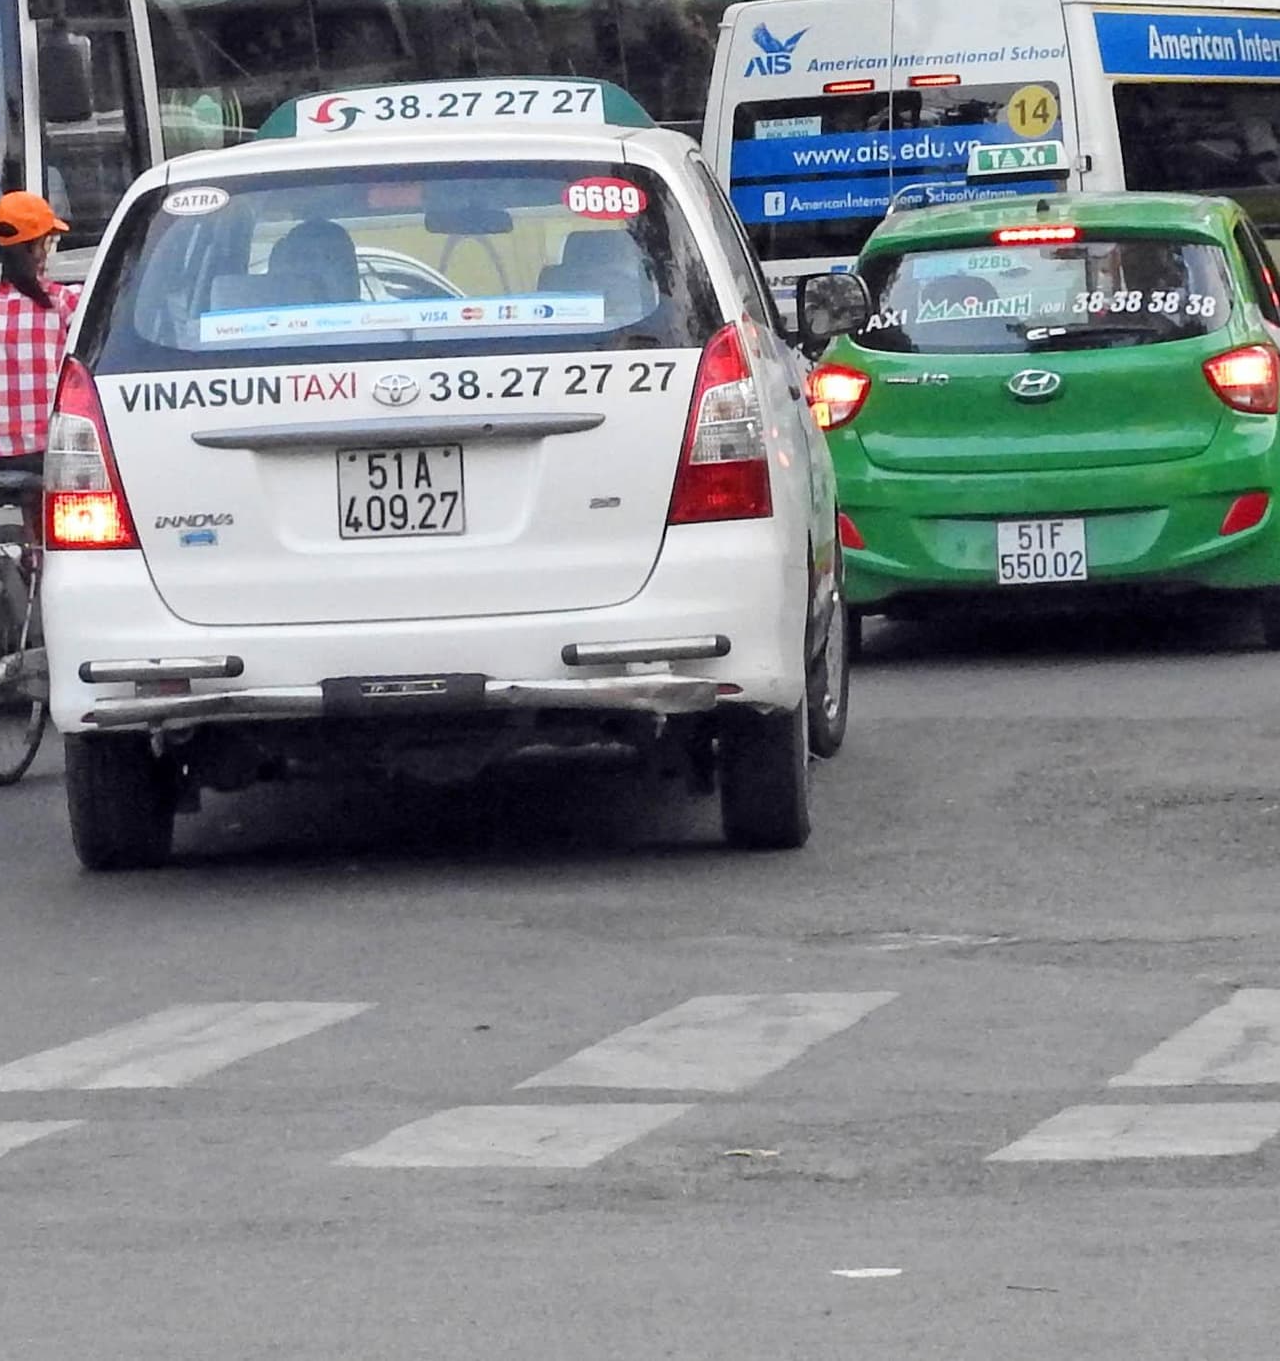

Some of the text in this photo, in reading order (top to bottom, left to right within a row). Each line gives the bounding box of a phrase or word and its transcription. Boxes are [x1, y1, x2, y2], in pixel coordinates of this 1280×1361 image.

[1148, 23, 1236, 61] American
[744, 54, 793, 78] AIS
[807, 44, 1066, 73] American International School
[374, 87, 597, 122] 38.27 27 27
[1014, 97, 1050, 127] 14
[170, 193, 220, 209] SATRA
[568, 184, 641, 214] 6689
[420, 310, 448, 323] VISA
[857, 309, 907, 336] AXI
[1072, 291, 1105, 314] 38
[1110, 290, 1144, 314] 38
[1148, 291, 1181, 315] 38
[1185, 294, 1217, 318] 38
[428, 366, 550, 402] 38.27
[564, 363, 613, 396] 27
[628, 361, 678, 393] 27
[367, 451, 434, 491] 51A
[344, 490, 460, 532] 409.27
[1017, 522, 1064, 550] 51F
[1000, 550, 1084, 580] 550.02
